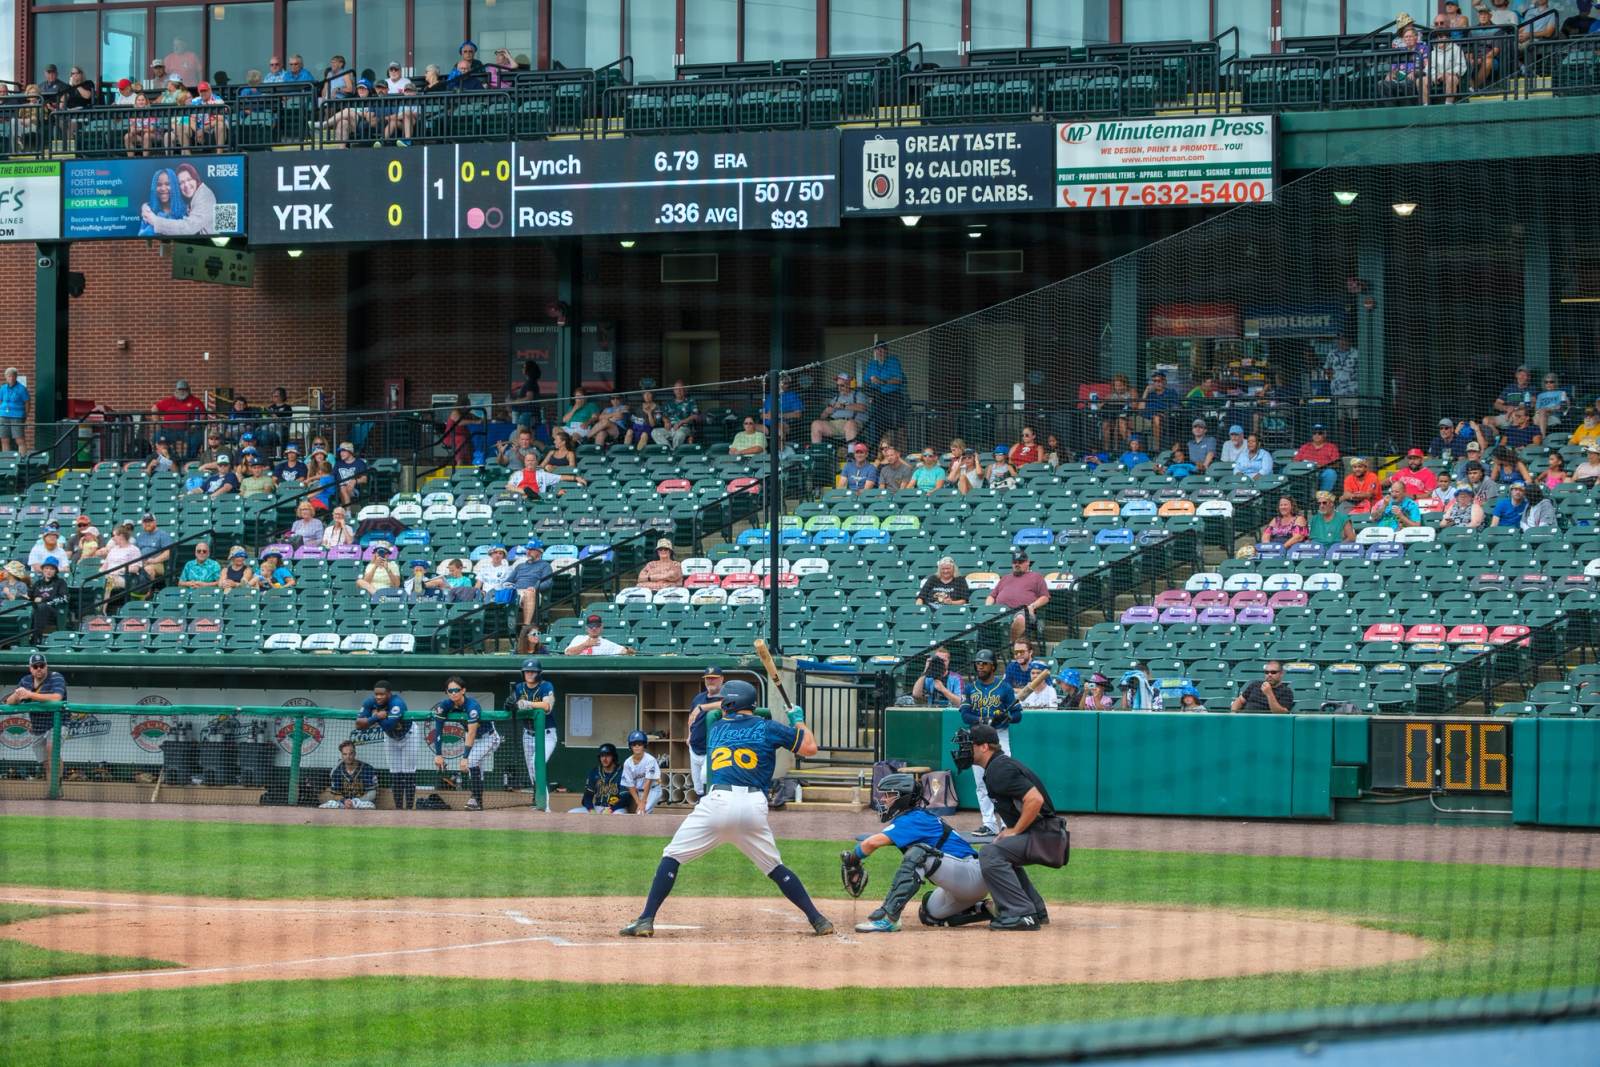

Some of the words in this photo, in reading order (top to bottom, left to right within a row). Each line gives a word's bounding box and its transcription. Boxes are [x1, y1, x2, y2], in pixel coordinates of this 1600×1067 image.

[1096, 120, 1208, 141] Minuteman
[1211, 118, 1264, 137] Press
[905, 135, 959, 153] GREAT
[964, 132, 1022, 151] TASTE.
[1101, 147, 1112, 155] WE
[1147, 145, 1170, 153] PRINT
[519, 154, 581, 180] Lynch
[654, 151, 699, 172] 6.79
[714, 153, 748, 169] ERA
[866, 153, 897, 173] Lite
[1121, 155, 1205, 163] www.minuteman.com
[277, 165, 331, 192] LEX
[387, 160, 403, 182] 0
[905, 162, 924, 179] 96
[71, 188, 95, 196] FOSTER
[433, 178, 444, 200] 1
[905, 187, 941, 205] 3.2G
[945, 187, 967, 203] OF
[971, 185, 1033, 203] CARBS.
[1083, 181, 1265, 207] 717-632-5400
[71, 199, 97, 207] FOSTER
[99, 198, 119, 206] CARE
[273, 204, 334, 230] YRK
[387, 204, 403, 227] 0
[519, 207, 573, 227] Ross
[655, 203, 699, 224] .336
[705, 208, 737, 223] AVG
[771, 210, 808, 229] $93
[711, 747, 758, 771] 20
